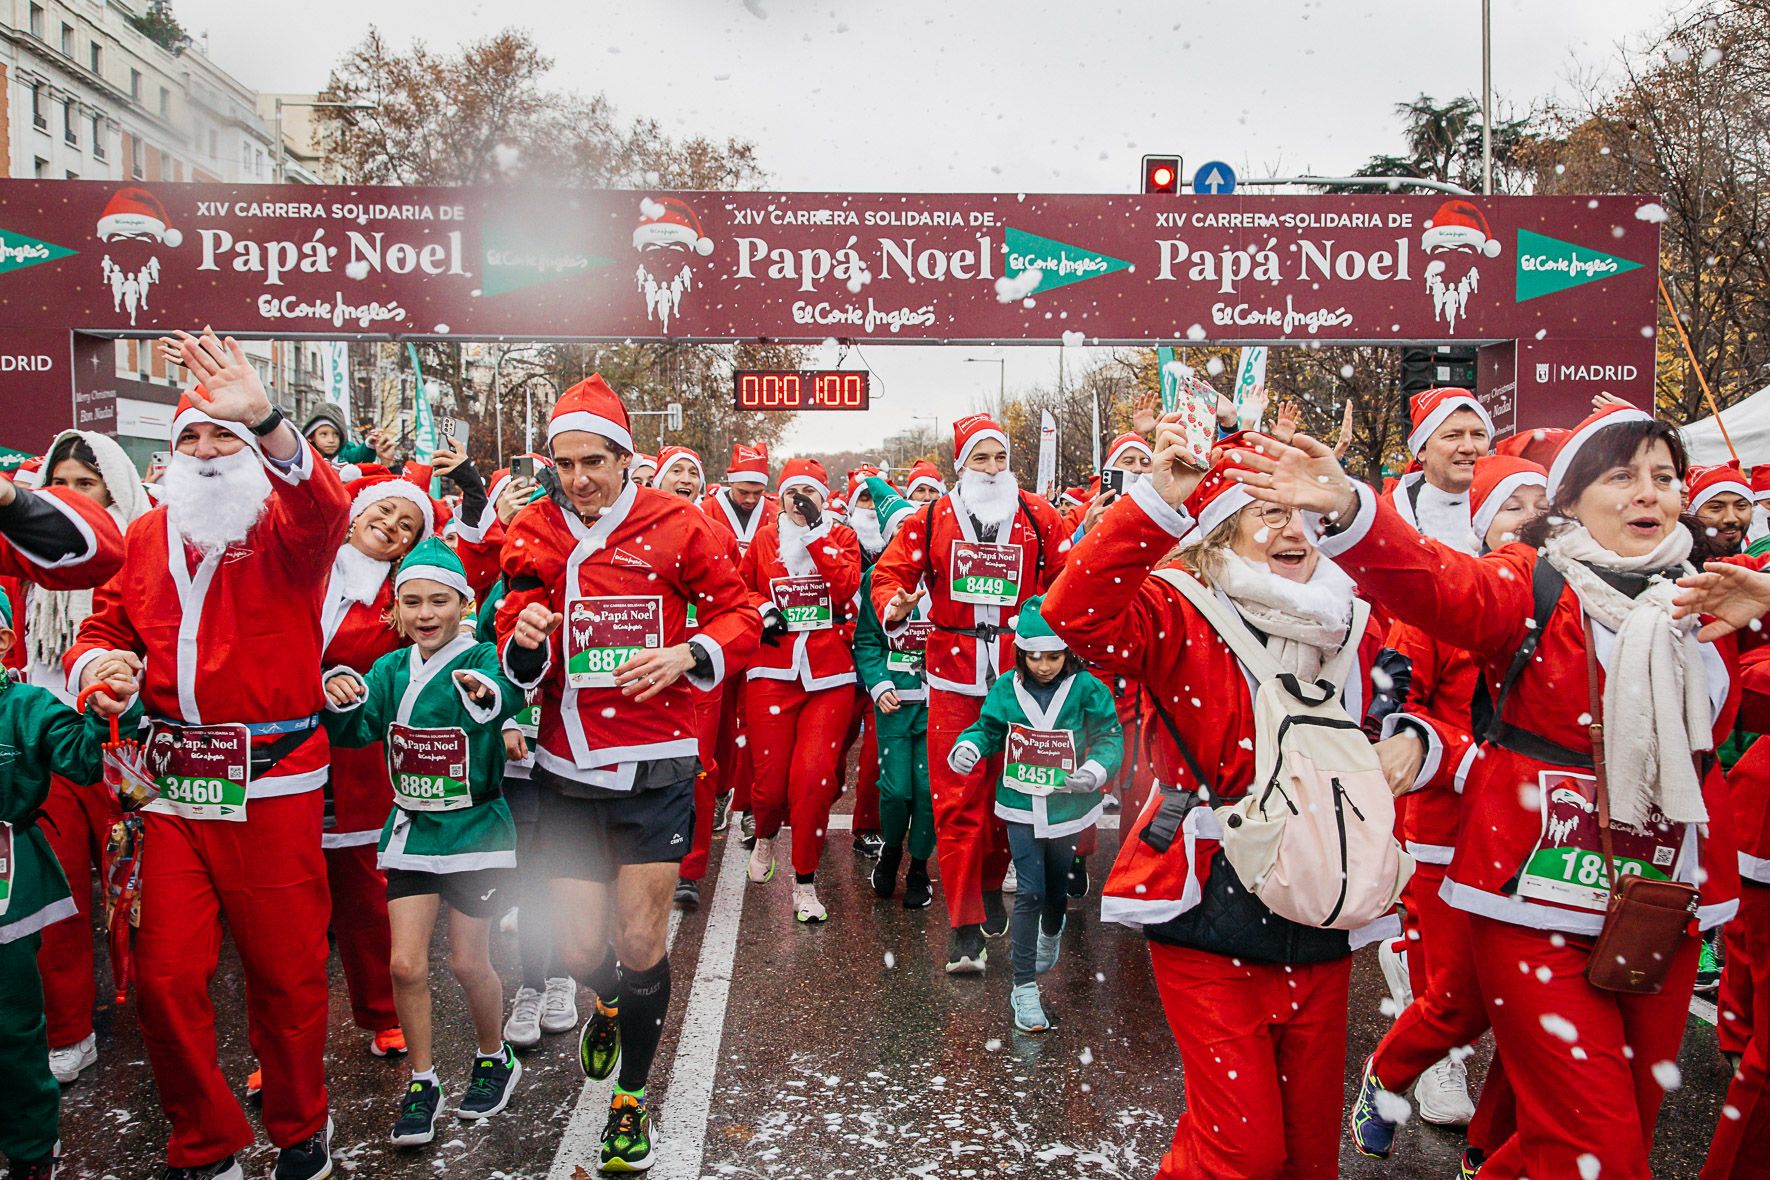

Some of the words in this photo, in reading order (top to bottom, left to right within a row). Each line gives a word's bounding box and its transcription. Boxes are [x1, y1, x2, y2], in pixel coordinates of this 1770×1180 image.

[196, 202, 229, 216] XIV
[235, 203, 326, 218] CARRERA
[332, 204, 433, 220] SOLIDARIA
[440, 206, 464, 221] DE
[734, 210, 765, 225] XIV
[771, 210, 859, 225] CARRERA
[864, 211, 964, 226] SOLIDARIA
[969, 212, 994, 226] DE
[1156, 213, 1186, 227] XIV
[1192, 213, 1279, 227] CARRERA
[1284, 213, 1382, 228] SOLIDARIA
[1388, 214, 1412, 228] DE
[195, 228, 332, 285] Papá
[346, 231, 465, 274] Noel
[733, 235, 862, 292] Papá
[877, 236, 994, 281] Noel
[1009, 254, 1024, 270] El
[1025, 254, 1058, 271] Corte
[1155, 237, 1283, 293] Papá
[1297, 237, 1412, 281] Noel
[1521, 255, 1535, 271] El
[1536, 255, 1569, 272] Corte
[258, 295, 280, 317] El
[281, 296, 331, 319] Corte
[332, 291, 406, 327] Inglés
[792, 301, 812, 324] El
[813, 302, 863, 325] Corte
[1212, 303, 1233, 325] El
[1233, 304, 1281, 326] Corte
[1283, 294, 1352, 334] Inglés
[0, 355, 53, 371] DRID
[1561, 365, 1637, 381] MADRID
[978, 551, 996, 561] Papá
[998, 553, 1015, 561] Noel
[966, 576, 1003, 594] 8449
[601, 610, 628, 623] Papá
[630, 610, 653, 620] Noel
[787, 605, 818, 622] 5722
[211, 738, 238, 750] Noel
[407, 740, 431, 752] Papá
[434, 740, 458, 751] Noel
[1029, 738, 1050, 749] Papá
[1052, 740, 1070, 748] Noel
[1017, 764, 1055, 785] 8451
[166, 777, 223, 803] 3460
[400, 774, 445, 797] 8884
